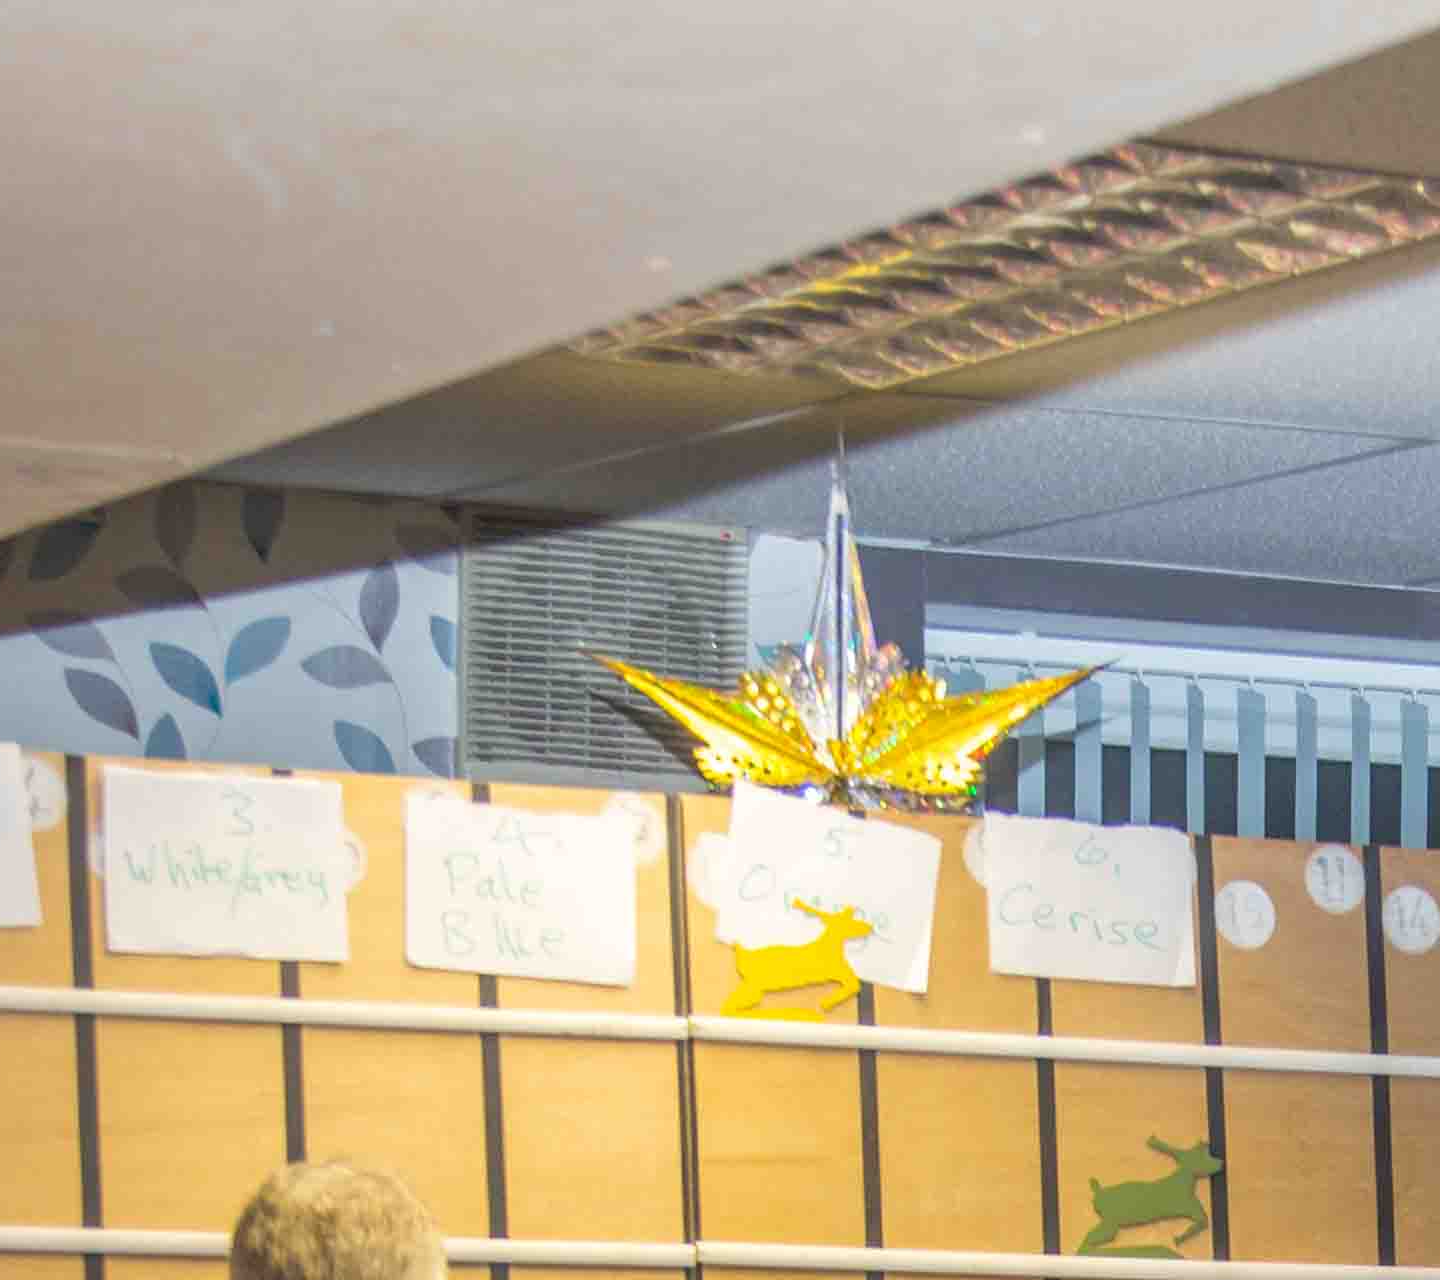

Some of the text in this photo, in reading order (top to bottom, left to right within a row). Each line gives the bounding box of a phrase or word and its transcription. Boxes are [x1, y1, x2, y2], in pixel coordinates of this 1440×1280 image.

[221, 789, 255, 836] 3
[442, 852, 545, 908] Pale
[998, 883, 1170, 951] Cerise
